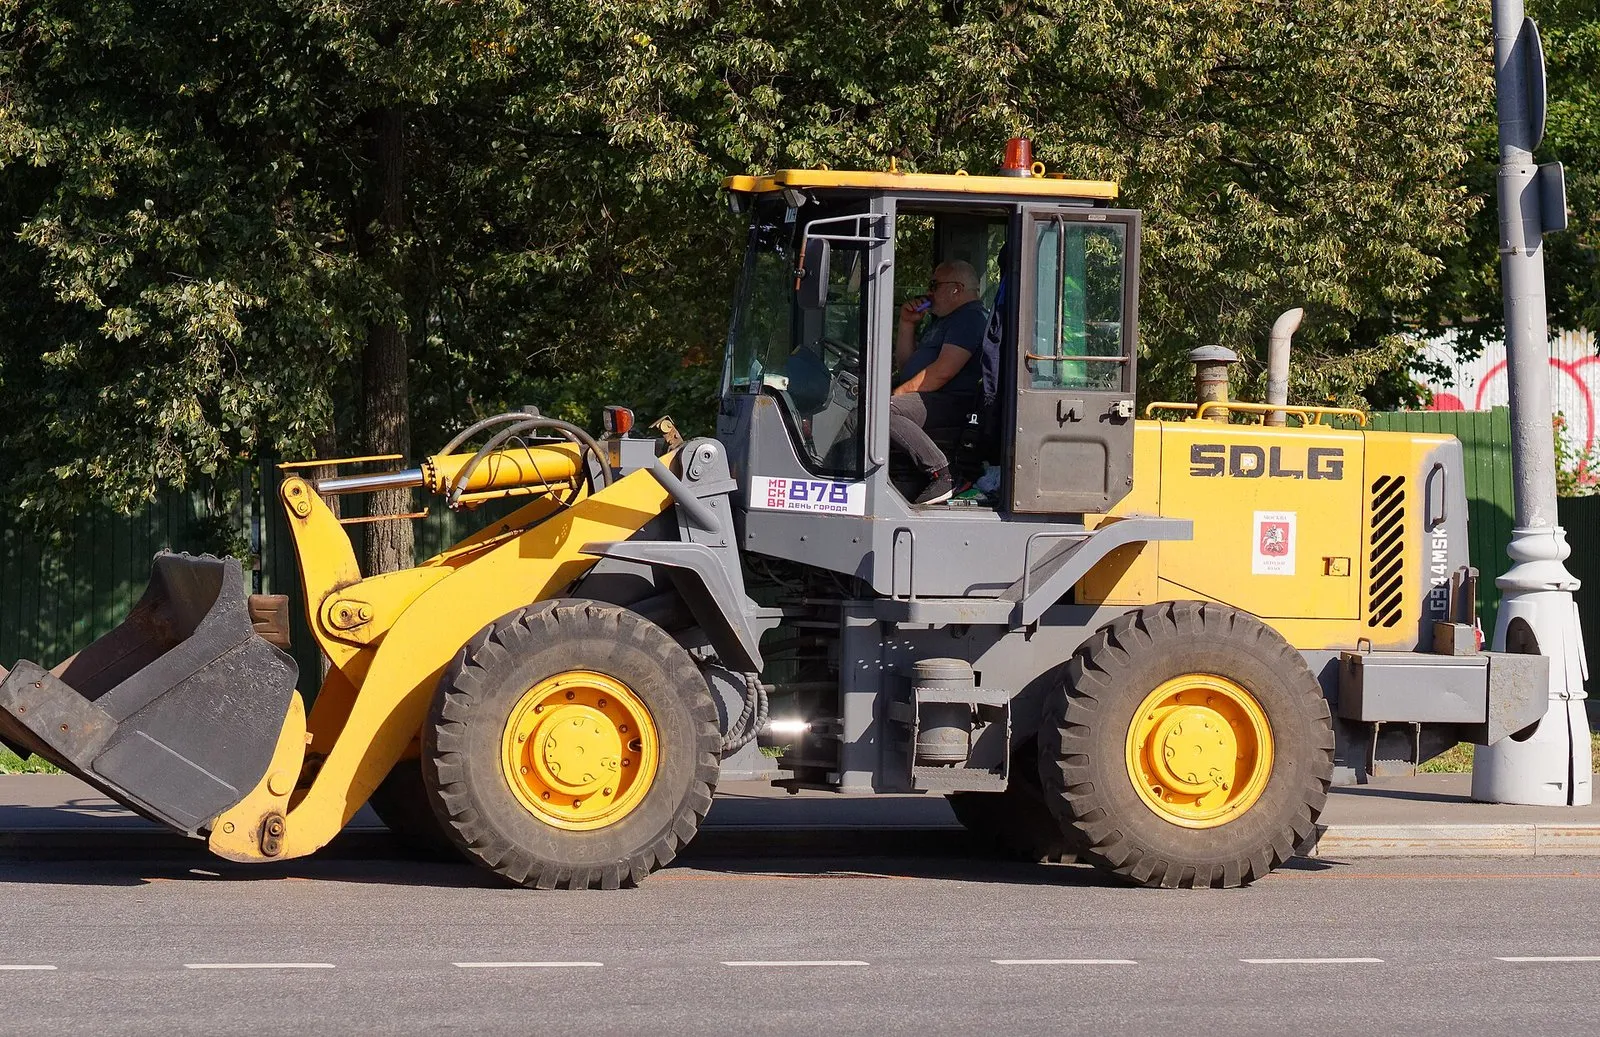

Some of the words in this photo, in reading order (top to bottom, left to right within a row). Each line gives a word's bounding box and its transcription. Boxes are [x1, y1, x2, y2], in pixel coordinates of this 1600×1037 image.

[1190, 444, 1344, 480] SDLG
[768, 479, 787, 488] МО
[768, 488, 786, 498] СК
[789, 480, 848, 504] 878
[767, 498, 785, 508] ВА
[788, 502, 812, 510] ДЕНЬ
[813, 503, 848, 512] ГОРОДА
